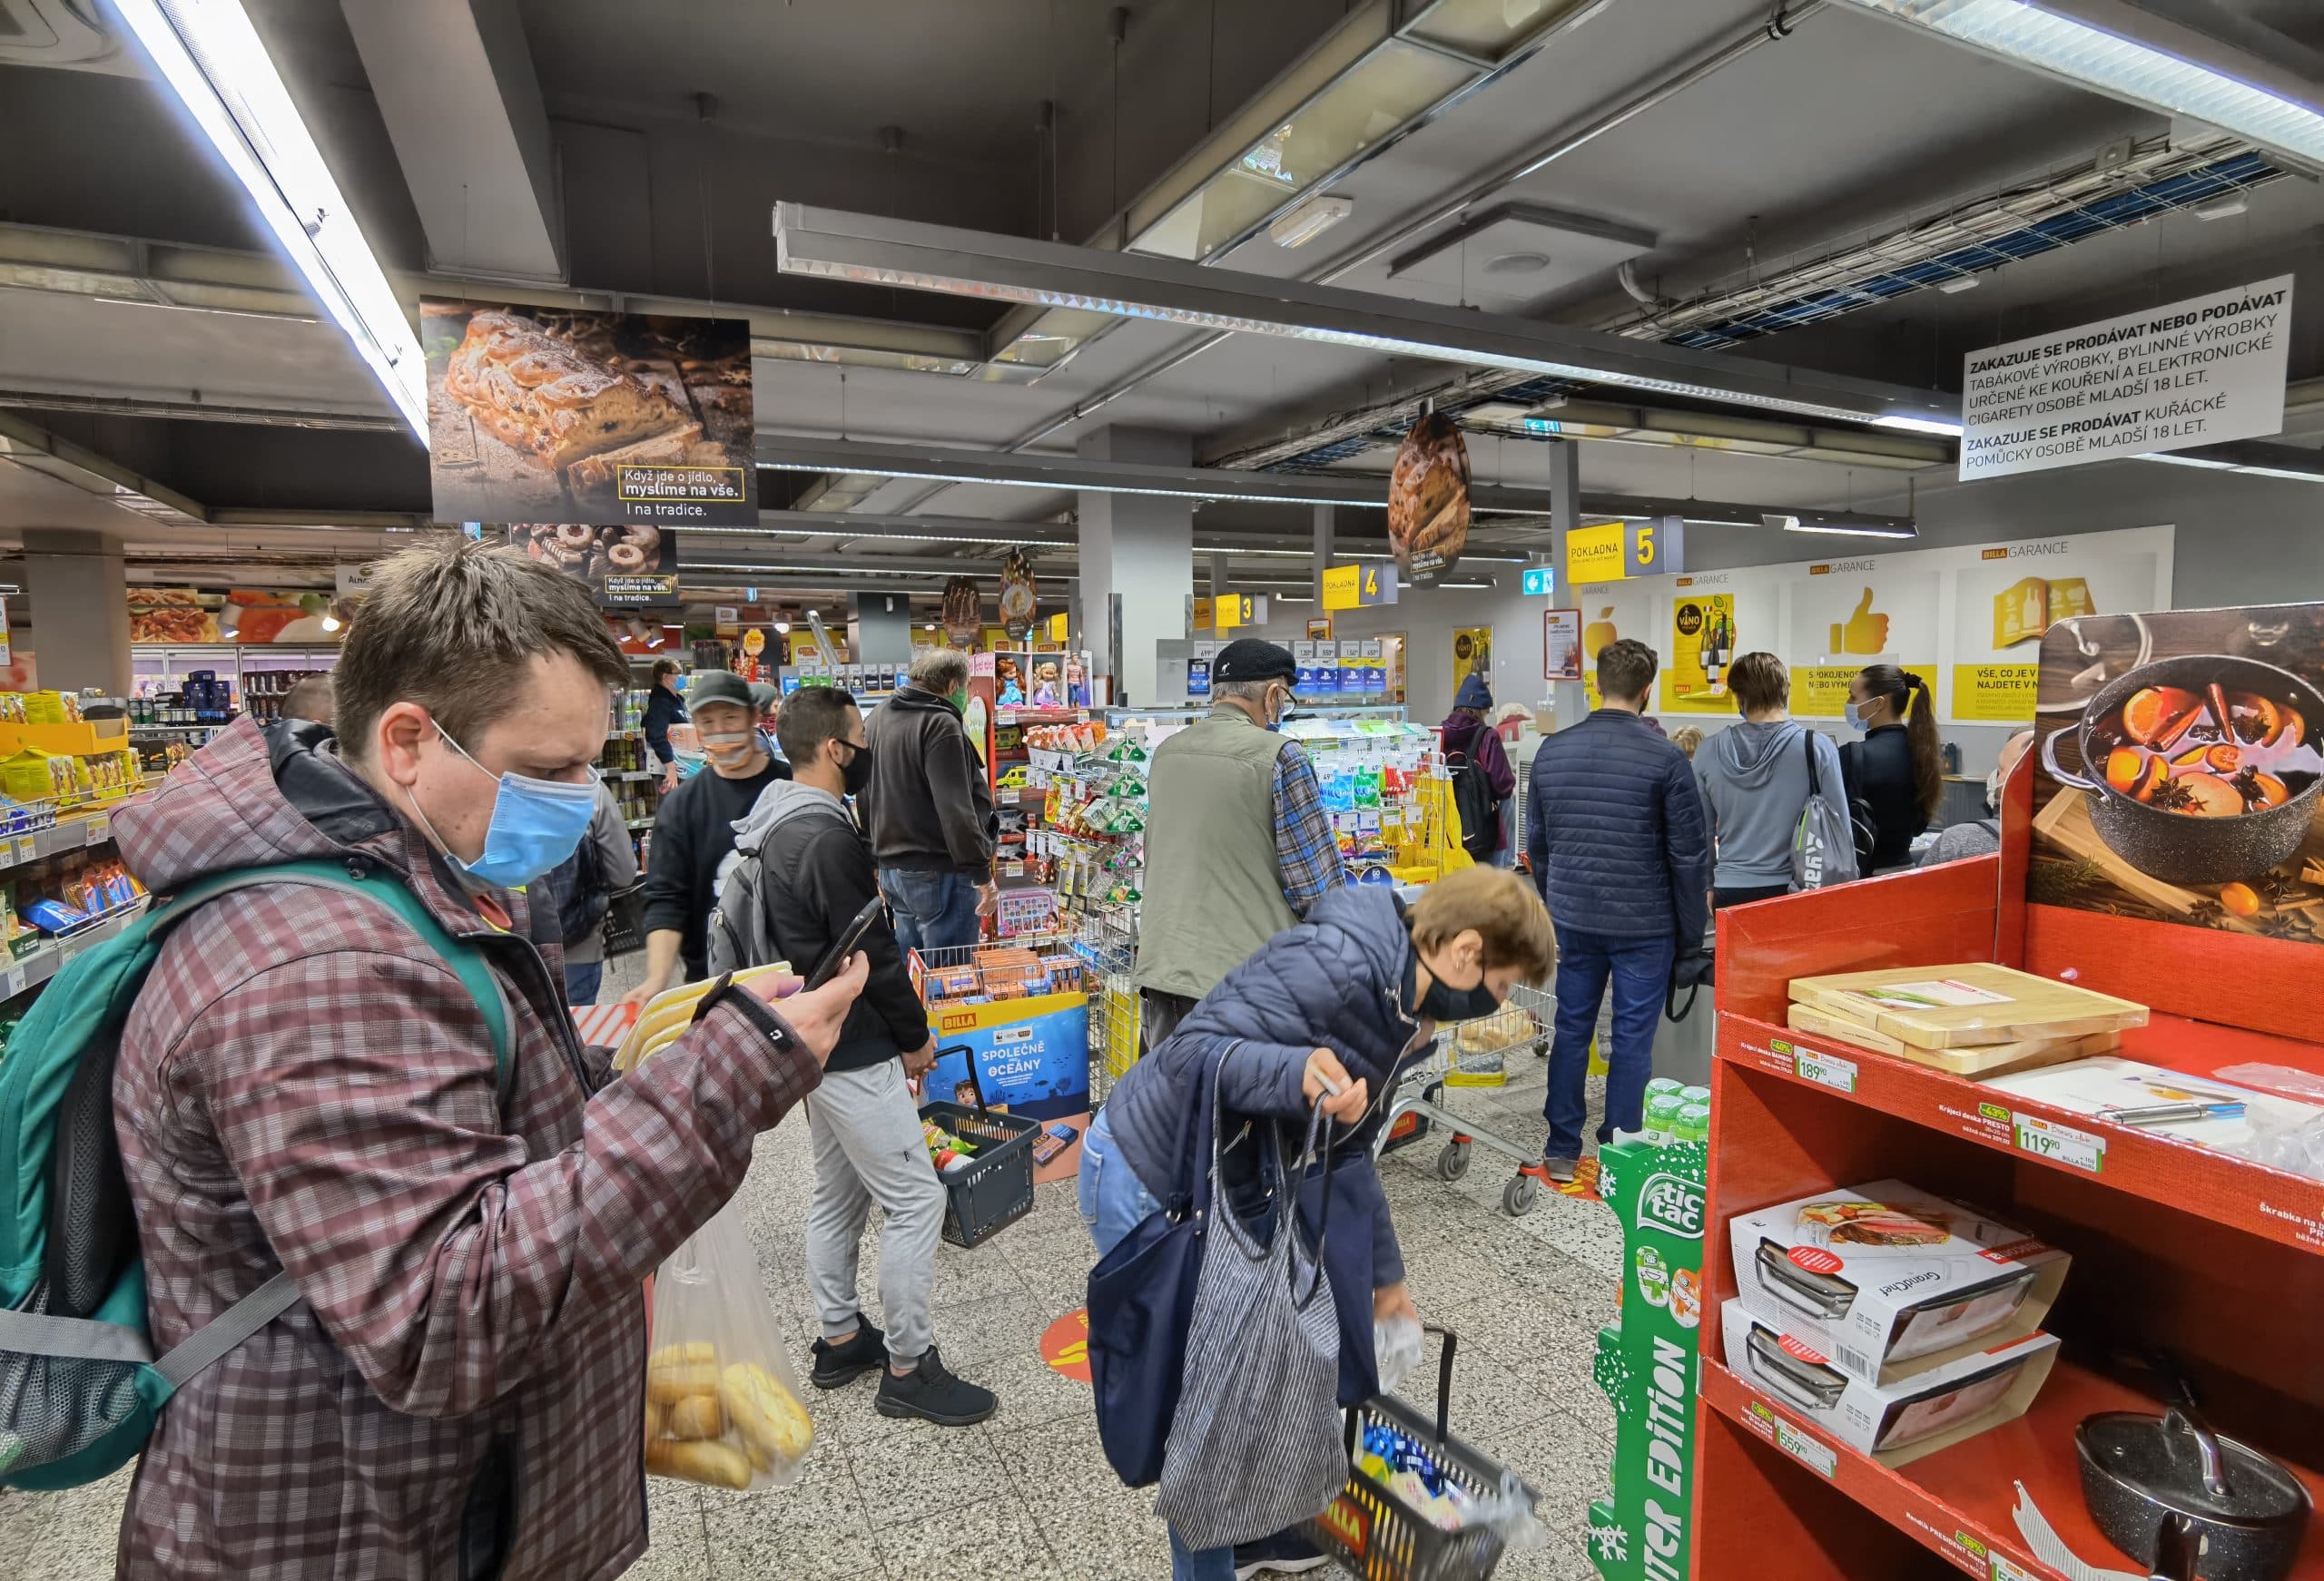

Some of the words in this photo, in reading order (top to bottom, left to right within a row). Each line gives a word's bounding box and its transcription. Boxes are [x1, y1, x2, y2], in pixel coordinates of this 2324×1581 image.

[1970, 349, 2041, 374] ZAKAZUJE
[2043, 343, 2063, 358] SE
[2065, 323, 2147, 353] PRODÁVAT
[2150, 312, 2198, 334] NEBO
[2201, 290, 2287, 322] PODÁVAT
[1970, 364, 2039, 391] TABÁKOVÉ
[2043, 351, 2113, 376] VÝROBKY,
[2118, 329, 2190, 360] BYLINNÉ
[2194, 313, 2279, 344] VÝROBKY
[1969, 385, 2025, 408] URČENÉ
[2029, 383, 2049, 397] KE
[2052, 365, 2121, 393] KOUŘENÍ
[2122, 365, 2134, 379] A
[2138, 332, 2274, 376] ELEKTRONICKÉ
[1968, 404, 2034, 426] CIGARETY
[2036, 391, 2086, 414] OSOBĚ
[2090, 378, 2150, 404] MLADŠÍ
[2153, 378, 2171, 392] 18
[2175, 369, 2209, 388] LET.
[1967, 428, 2036, 451] ZAKAZUJE
[2039, 425, 2058, 439] SE
[2061, 410, 2142, 436] PRODÁVAT
[2144, 391, 2227, 421] KUŘÁCKÉ
[1966, 447, 2034, 468] POMŮCKY
[2035, 437, 2085, 458] OSOBĚ
[2089, 425, 2149, 450] MLADŠÍ
[2152, 425, 2170, 439] 18
[2174, 418, 2207, 436] LET.
[625, 469, 653, 484] Když
[656, 470, 675, 484] jde
[677, 474, 684, 482] o
[687, 471, 716, 484] jídlo,
[625, 483, 686, 497] myslíme
[690, 486, 707, 496] na
[711, 484, 738, 496] vše.
[626, 503, 630, 516] I
[635, 506, 651, 516] na
[655, 504, 707, 516] tradice.
[1571, 543, 1619, 558] POKLADNA
[1637, 528, 1655, 565] 5
[2008, 542, 2069, 558] GARANCE
[1830, 559, 1875, 574] GARANCE
[1365, 569, 1377, 596] 4
[1693, 574, 1729, 586] GARANCE
[1243, 597, 1252, 619] 3
[1977, 667, 1998, 679] VŠE,
[2000, 669, 2013, 677] CO
[2015, 669, 2027, 677] JE
[2030, 669, 2036, 677] V
[1977, 681, 2022, 689] NAJDETE
[2024, 681, 2030, 689] V
[944, 1014, 976, 1029] BILLA
[981, 1040, 1045, 1062] SPOLEČNĚ
[988, 1059, 1041, 1077] OCEÁNY
[1962, 1113, 1983, 1124] deska
[1983, 1117, 2010, 1132] PRESTO
[1981, 1106, 2008, 1120] -43%
[1663, 1182, 1701, 1213] tic
[1651, 1195, 1699, 1230] tac
[2260, 1201, 2301, 1223] Škrabka
[2303, 1218, 2316, 1228] na
[2295, 1232, 2320, 1246] běžná
[1879, 1272, 1941, 1297] GrandChef
